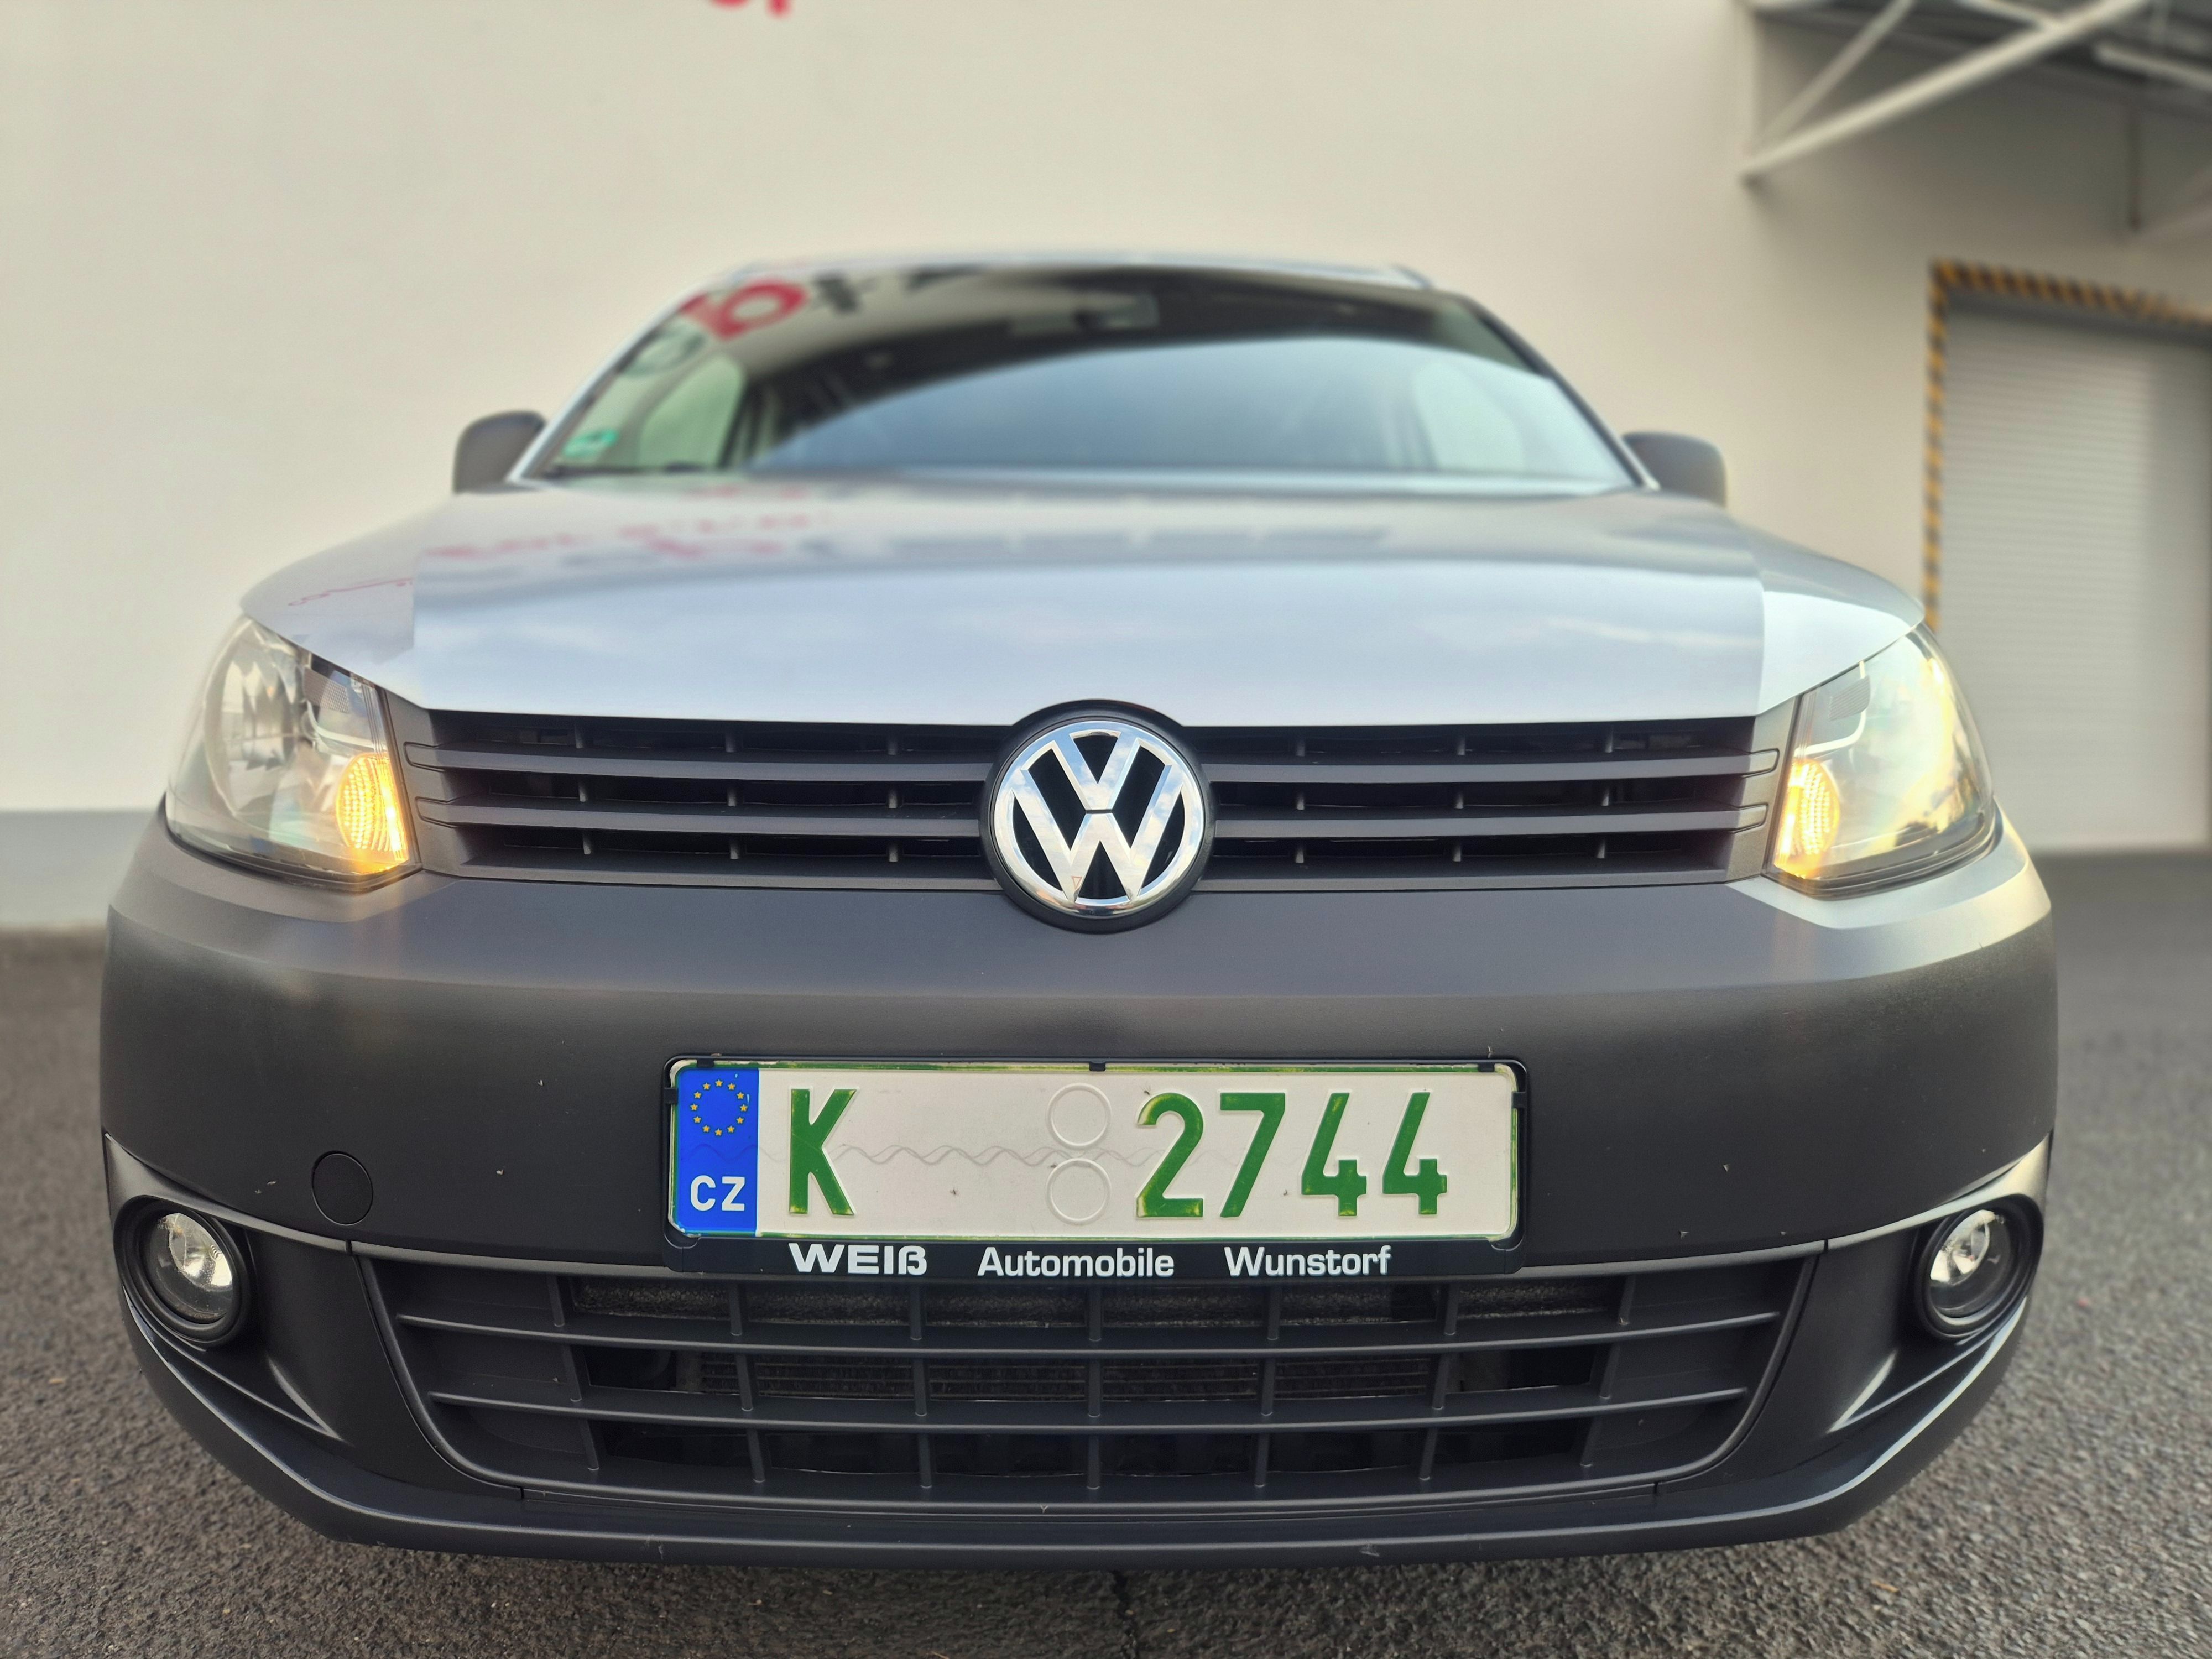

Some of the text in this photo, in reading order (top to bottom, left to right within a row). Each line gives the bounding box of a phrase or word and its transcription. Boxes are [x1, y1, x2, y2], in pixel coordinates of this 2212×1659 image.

[996, 722, 1202, 910] VW
[690, 1175, 745, 1212] CZ
[789, 1089, 1447, 1218] K 2744
[977, 1246, 1175, 1277] Automobile
[1224, 1245, 1391, 1276] Wunstorf
